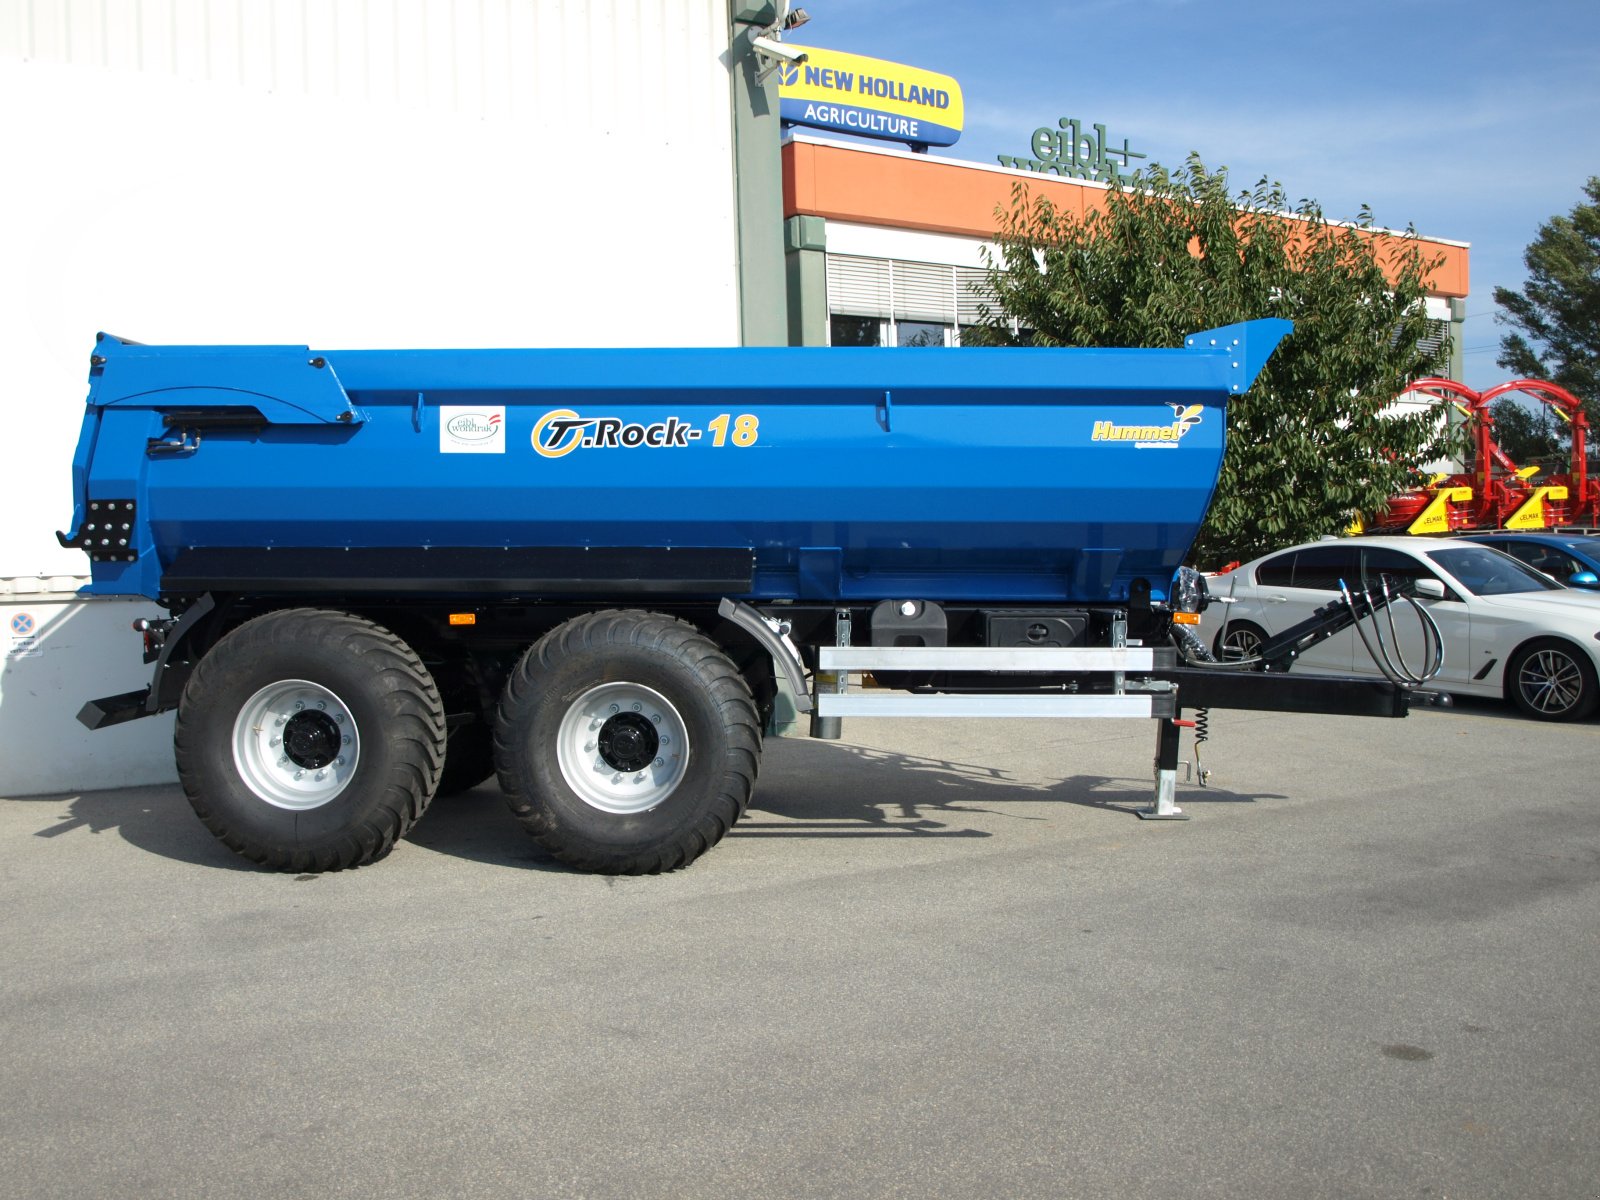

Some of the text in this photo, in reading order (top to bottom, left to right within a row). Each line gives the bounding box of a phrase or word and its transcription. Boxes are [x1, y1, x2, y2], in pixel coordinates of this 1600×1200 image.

[805, 65, 949, 109] NEW HOLLAND
[804, 103, 918, 137] AGRICULTURE
[1091, 421, 1180, 441] Hummel
